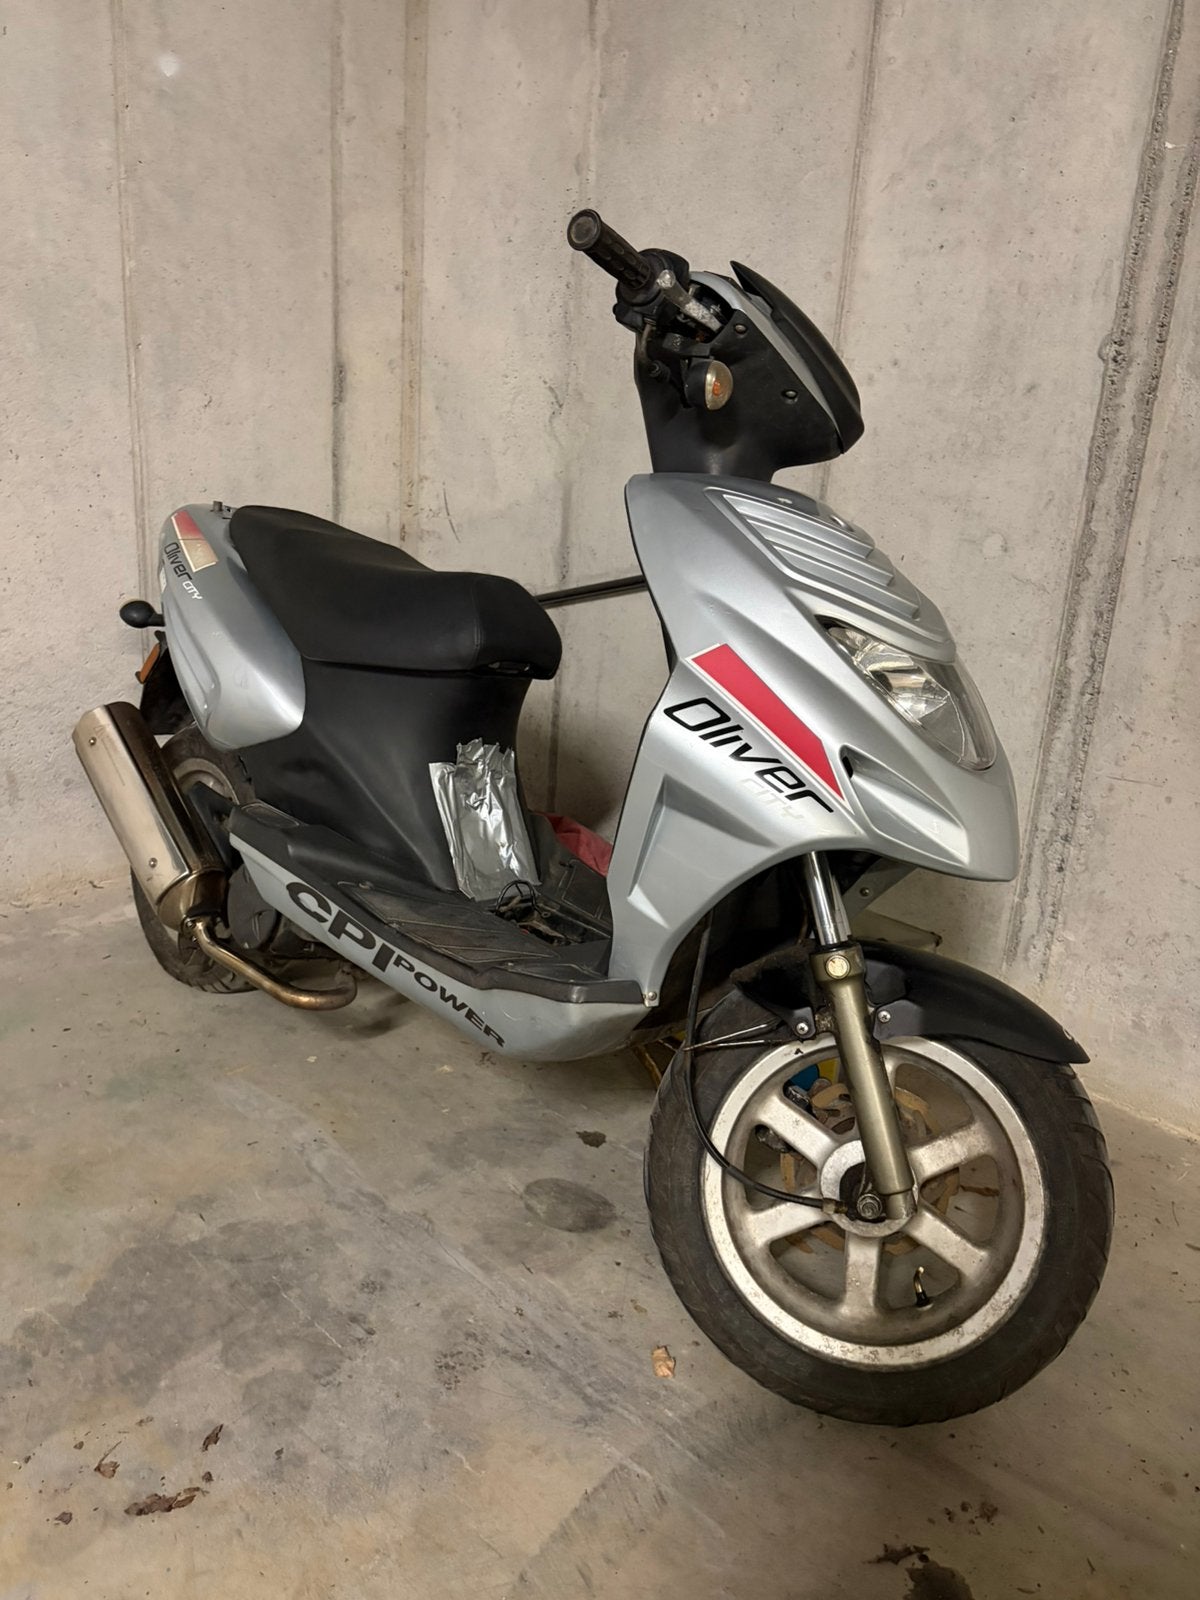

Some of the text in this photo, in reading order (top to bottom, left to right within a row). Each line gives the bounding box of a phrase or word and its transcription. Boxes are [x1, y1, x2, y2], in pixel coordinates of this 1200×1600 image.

[164, 542, 192, 580] Oliver
[663, 697, 834, 813] Oliver
[286, 882, 505, 1047] CPI POWER
